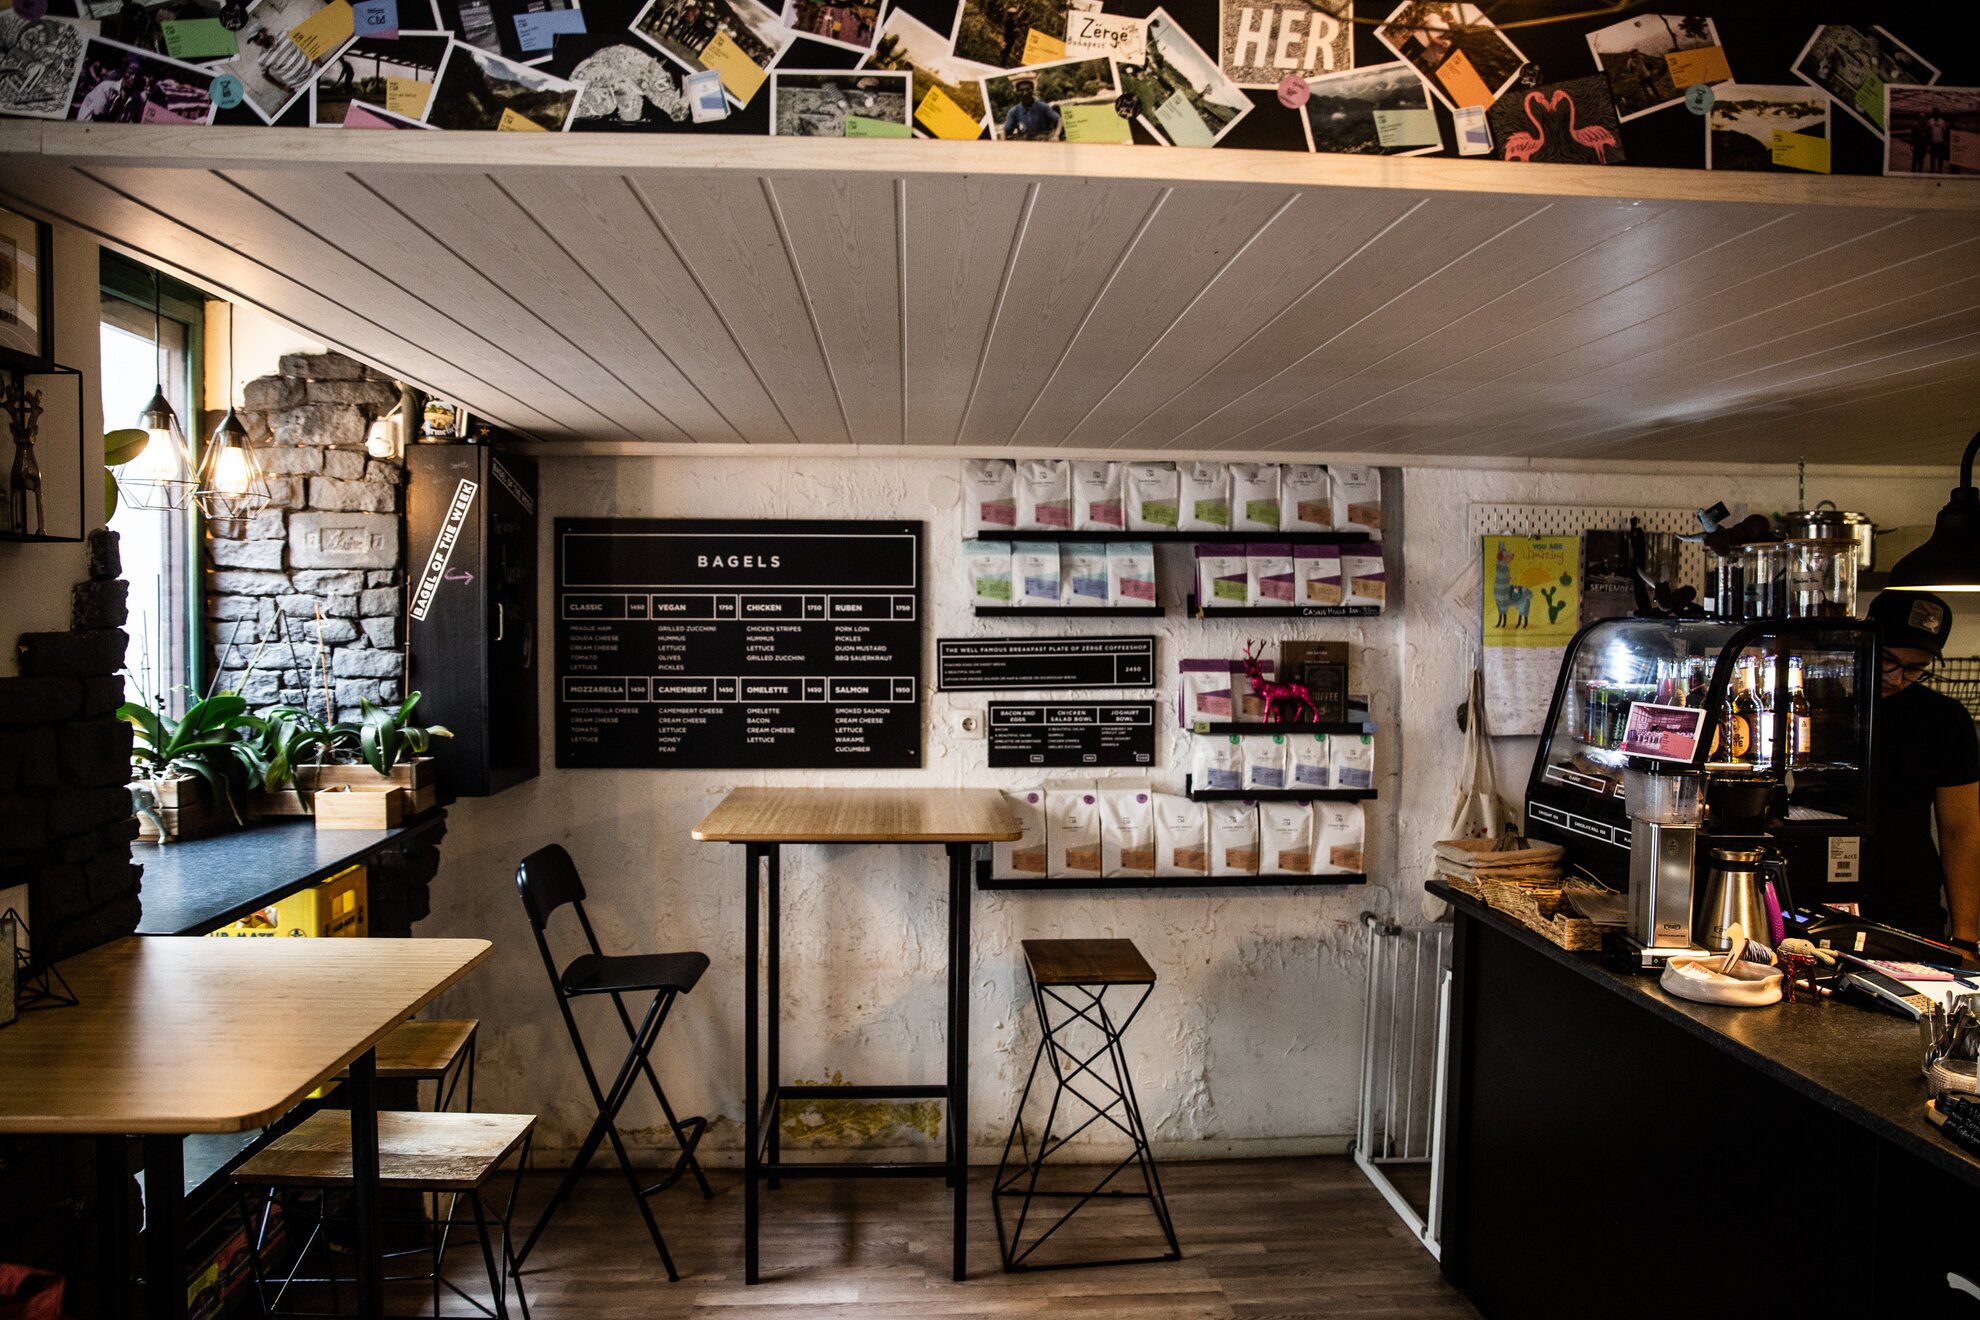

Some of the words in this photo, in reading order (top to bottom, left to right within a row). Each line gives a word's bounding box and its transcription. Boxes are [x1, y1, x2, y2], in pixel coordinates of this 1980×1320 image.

[1234, 7, 1339, 71] HER
[413, 575, 437, 616] BAGEL
[431, 552, 444, 571] OF
[439, 524, 457, 549] THE
[450, 483, 474, 521] WEEK
[697, 555, 781, 568] BAGELS
[746, 604, 782, 612] CHICKEN
[1105, 644, 1147, 652] COFFEESHOP
[658, 686, 708, 694] CAMEMBERT
[746, 686, 789, 694] OMELETTE
[835, 686, 869, 694] SALMON
